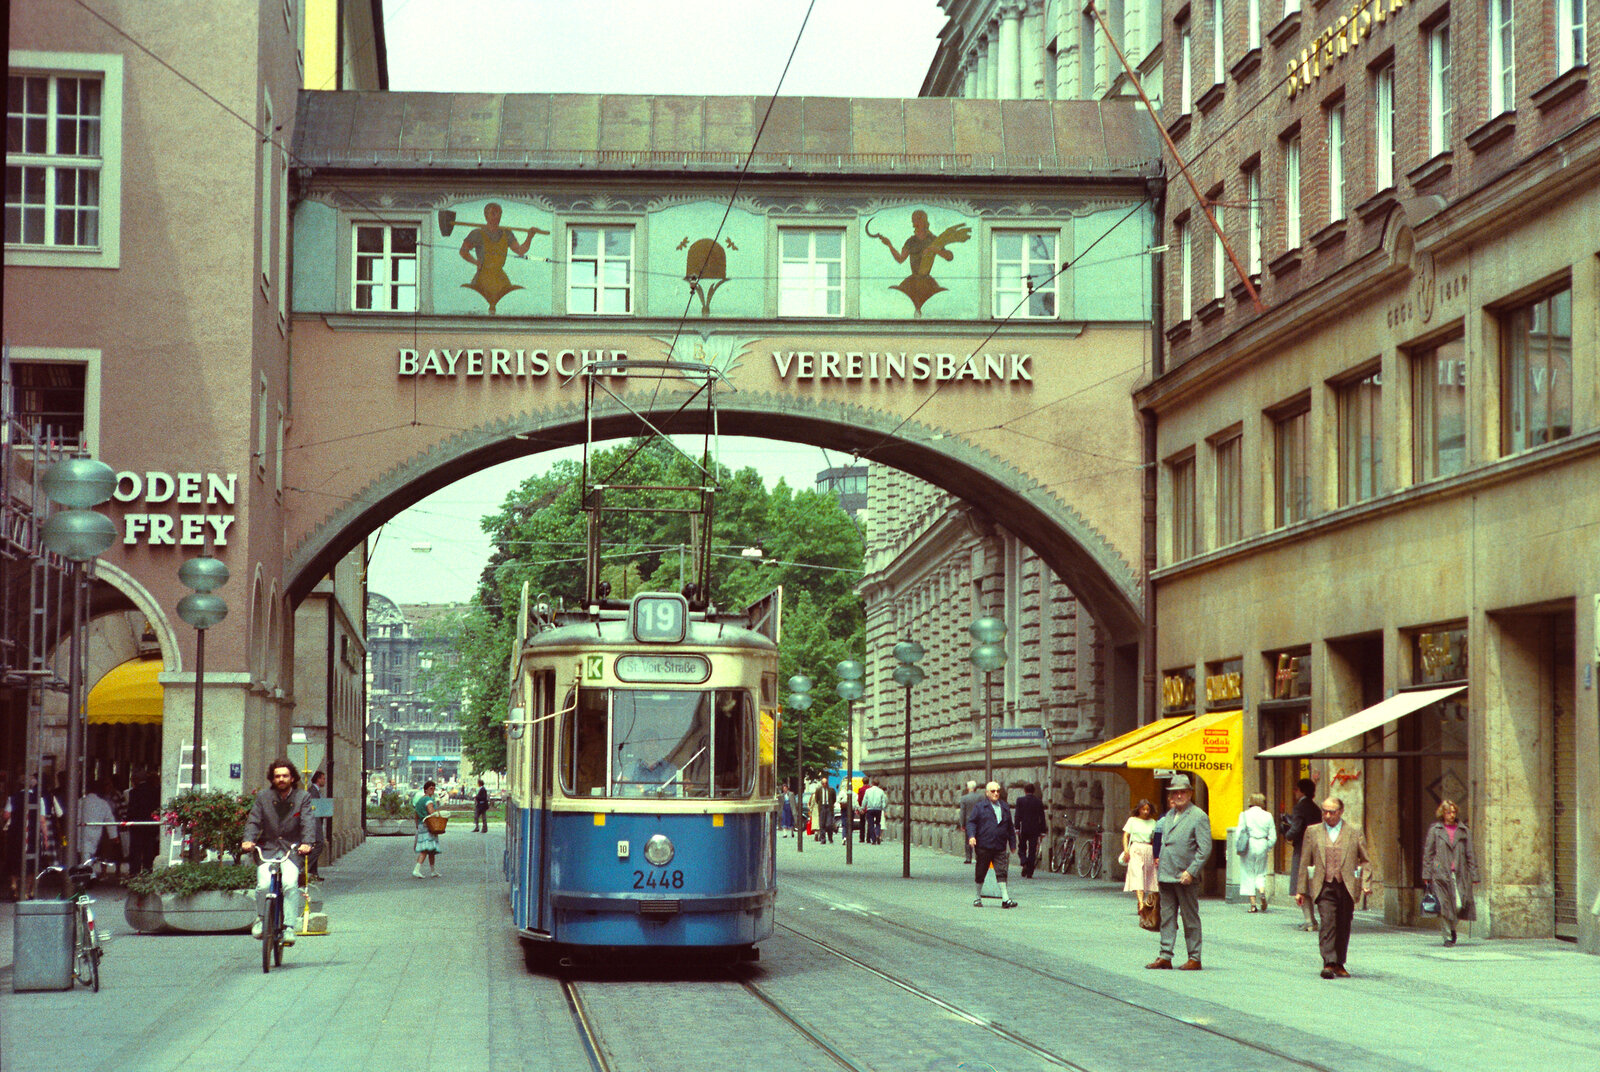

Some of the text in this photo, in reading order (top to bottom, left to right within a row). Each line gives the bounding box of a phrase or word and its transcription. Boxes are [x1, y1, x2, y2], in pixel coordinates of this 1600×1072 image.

[397, 348, 1034, 381] BAYERISCHE VEREINSBANK
[110, 470, 238, 505] ODEN
[123, 513, 235, 546] FREY
[641, 602, 675, 632] 19
[588, 657, 602, 678] K
[1202, 736, 1230, 746] Kodak
[1172, 752, 1207, 761] PHOTO
[1172, 761, 1233, 771] KOHLROSER
[619, 844, 628, 854] 10
[632, 869, 685, 890] 2448
